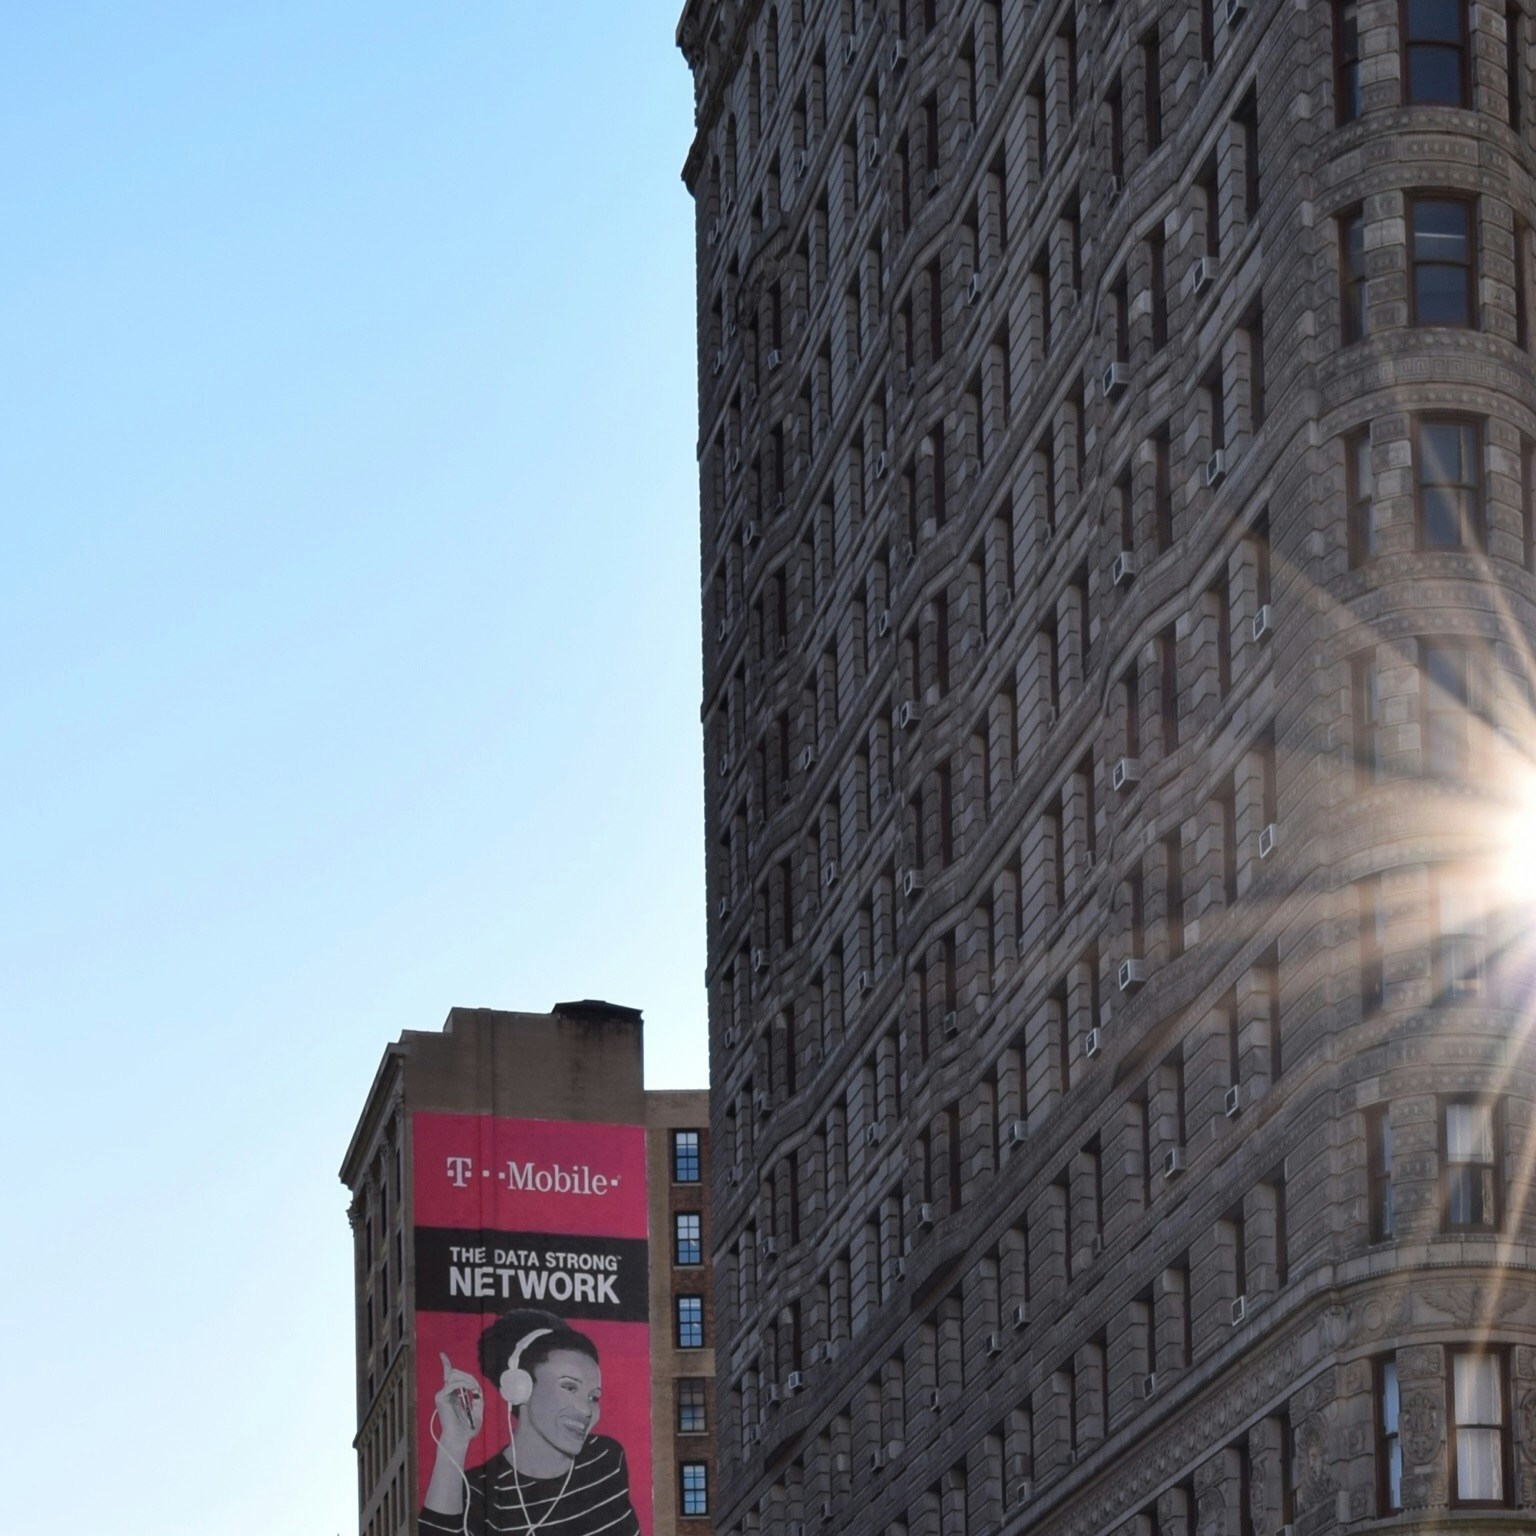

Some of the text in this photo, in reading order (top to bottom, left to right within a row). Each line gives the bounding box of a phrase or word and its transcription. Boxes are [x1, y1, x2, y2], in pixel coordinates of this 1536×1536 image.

[449, 1246, 618, 1271] THE DATA STRONG
[449, 1266, 620, 1304] NETWORK
